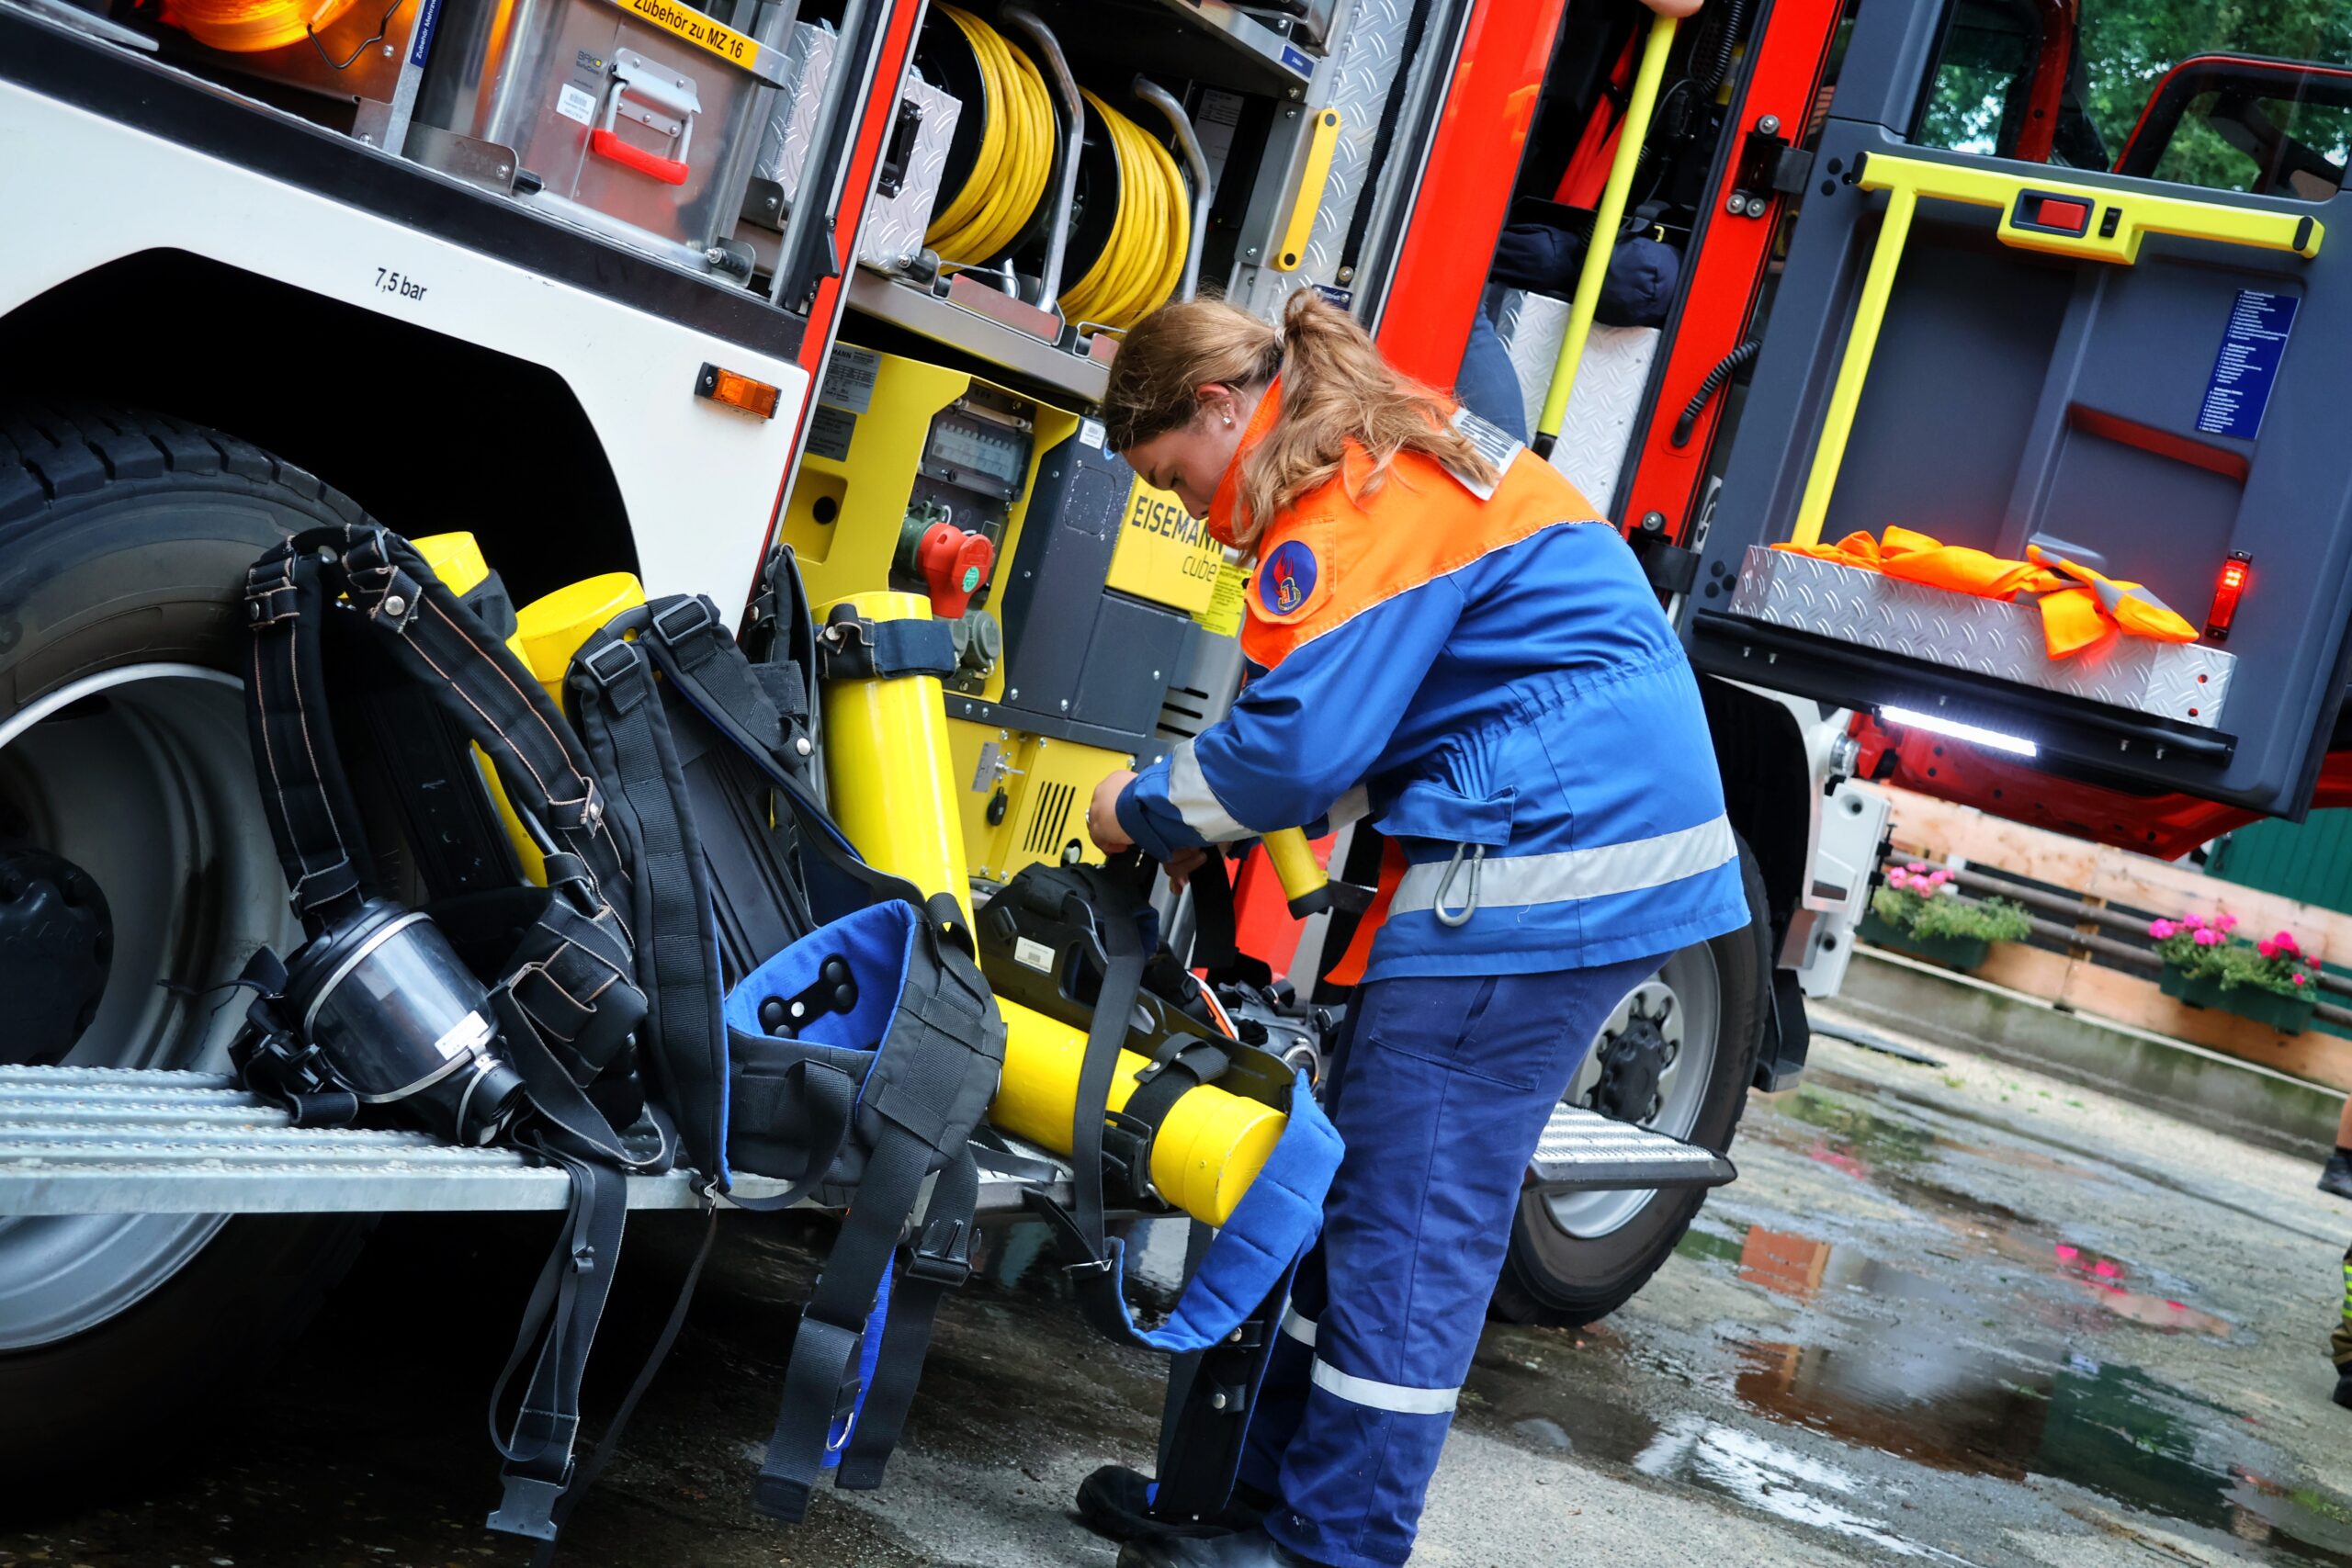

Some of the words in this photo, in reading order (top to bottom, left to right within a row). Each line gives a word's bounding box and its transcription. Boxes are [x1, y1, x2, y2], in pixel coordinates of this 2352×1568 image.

[634, 0, 688, 31] Zubehör
[688, 23, 705, 40] zu
[707, 28, 728, 51] MZ
[729, 39, 744, 59] 16
[375, 266, 400, 292] 7,5
[400, 275, 428, 301] bar
[1182, 554, 1217, 581] cube
